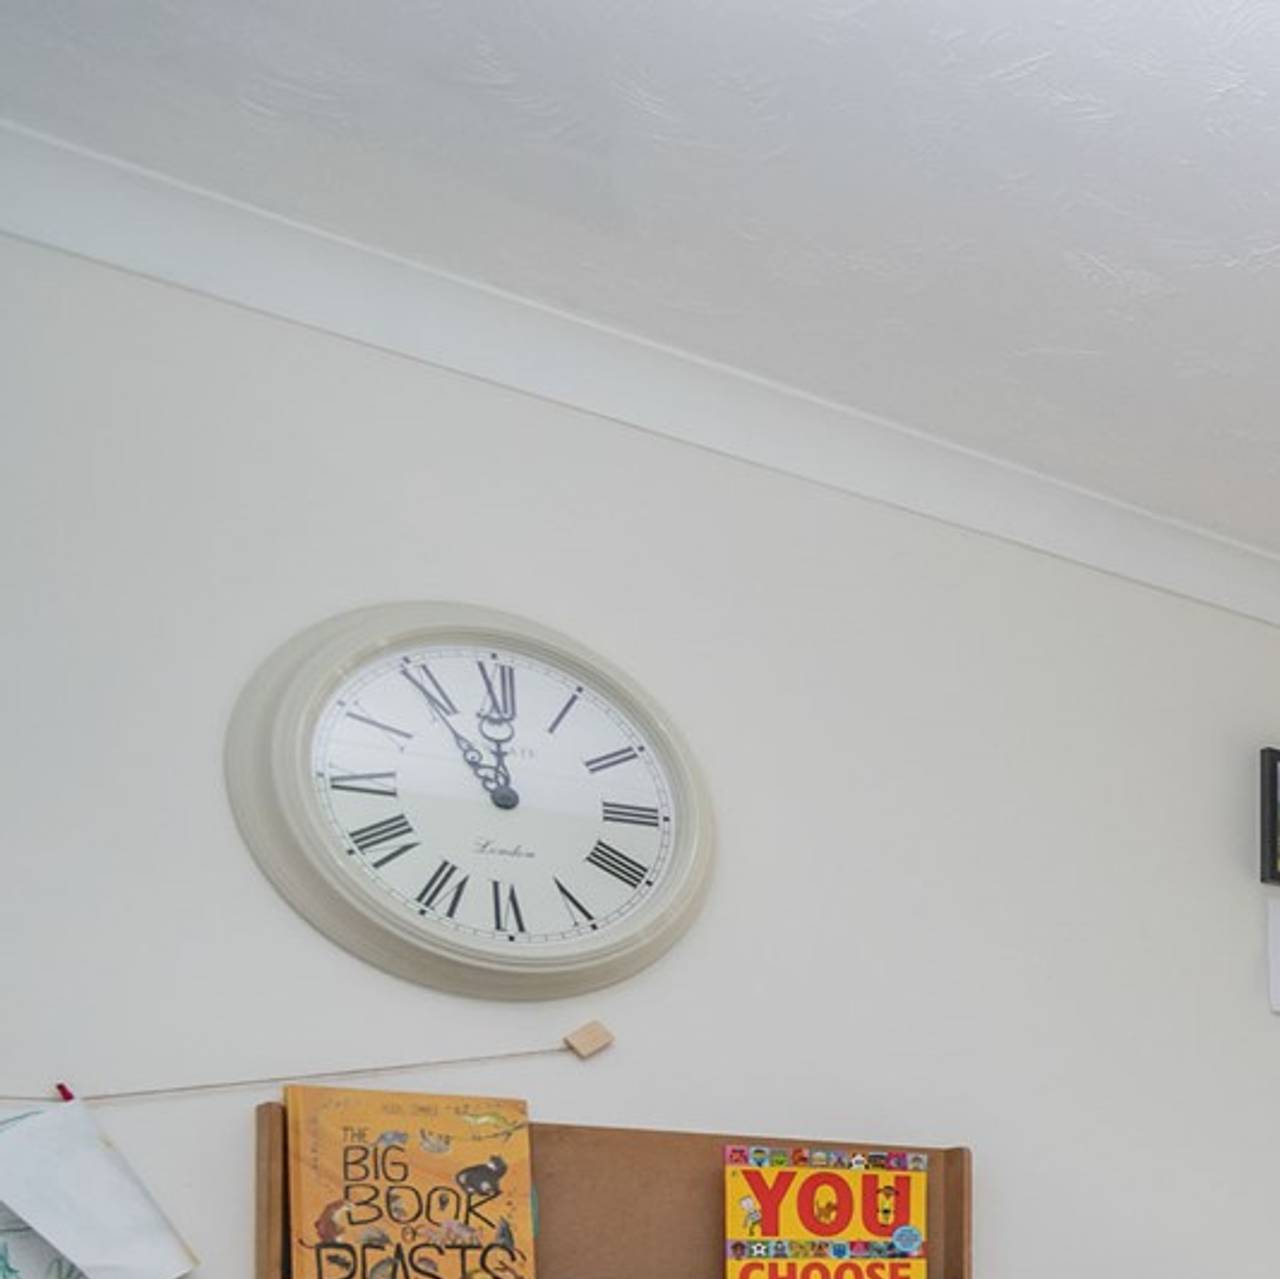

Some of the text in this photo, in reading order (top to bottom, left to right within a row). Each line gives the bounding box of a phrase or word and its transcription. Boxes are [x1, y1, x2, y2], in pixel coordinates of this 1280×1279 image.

[343, 1145, 409, 1183] BIG
[344, 1183, 502, 1228] BOOK
[741, 1169, 912, 1238] YOU
